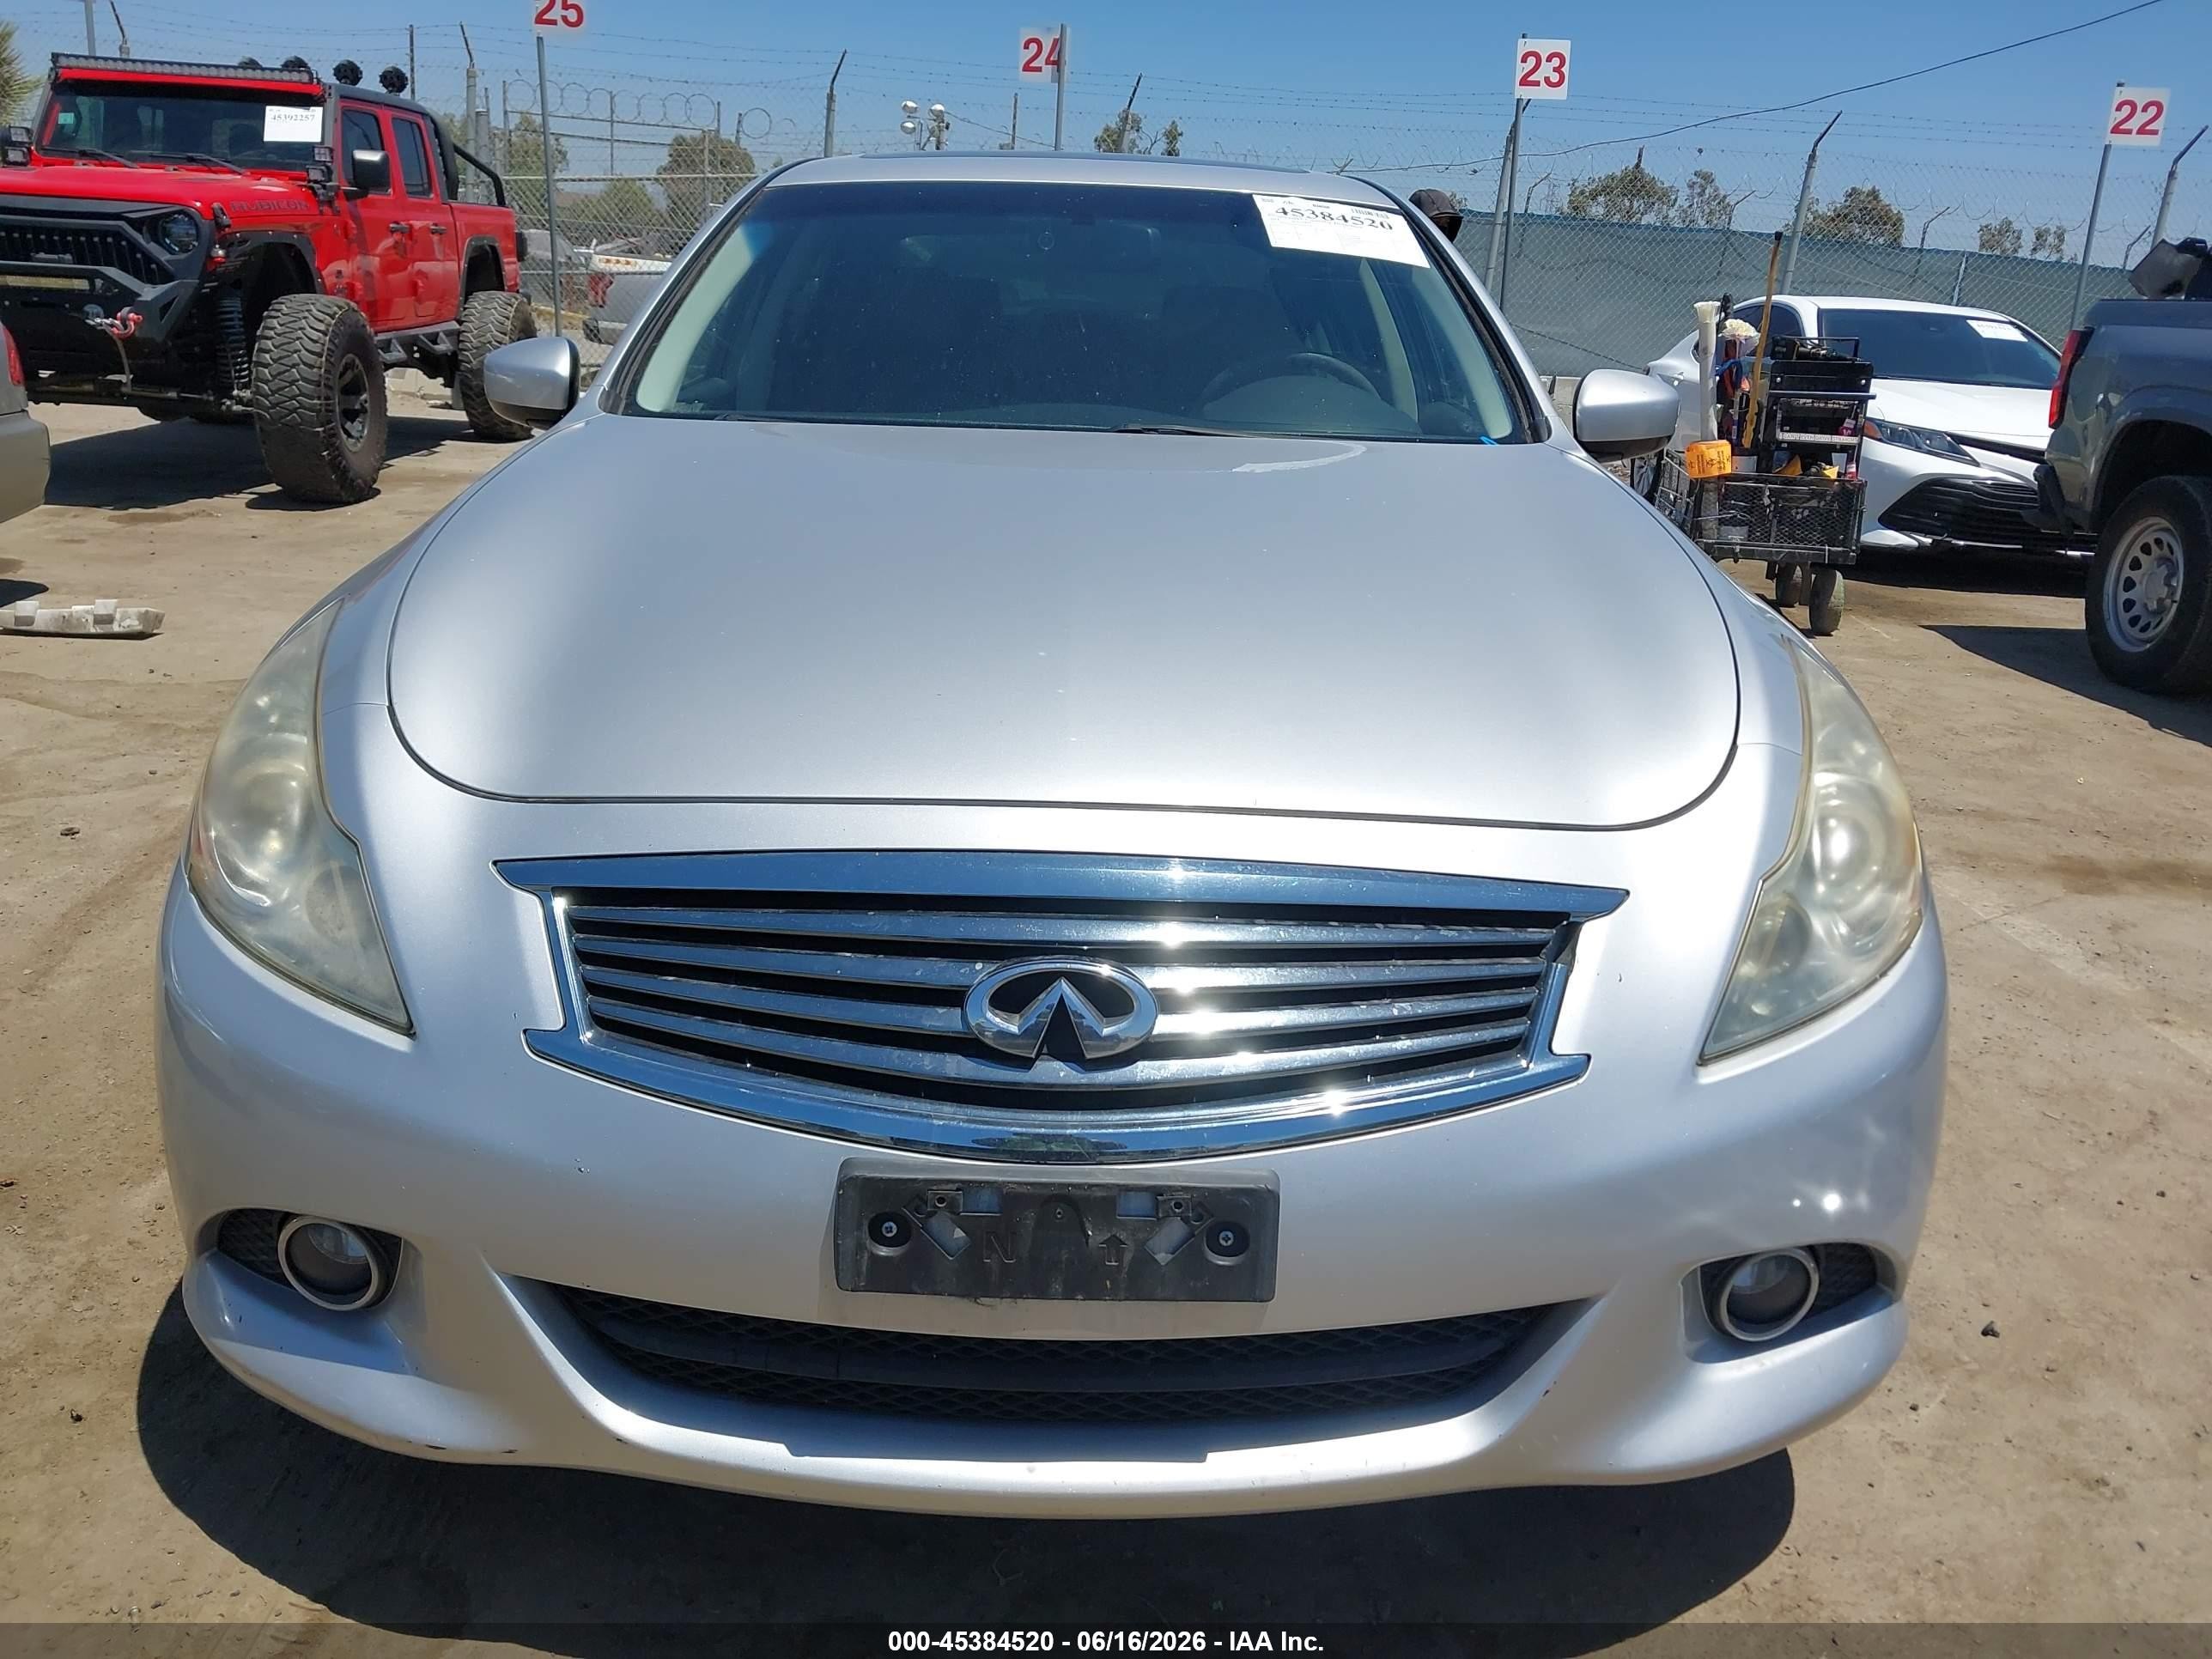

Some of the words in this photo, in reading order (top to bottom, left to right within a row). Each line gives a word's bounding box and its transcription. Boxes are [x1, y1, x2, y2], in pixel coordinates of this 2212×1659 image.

[534, 0, 584, 27] 25
[1022, 37, 1060, 72] 24
[1519, 50, 1566, 88] 23
[2110, 99, 2164, 135] 22
[230, 199, 309, 212] RUBICON
[1274, 206, 1394, 231] 45384520
